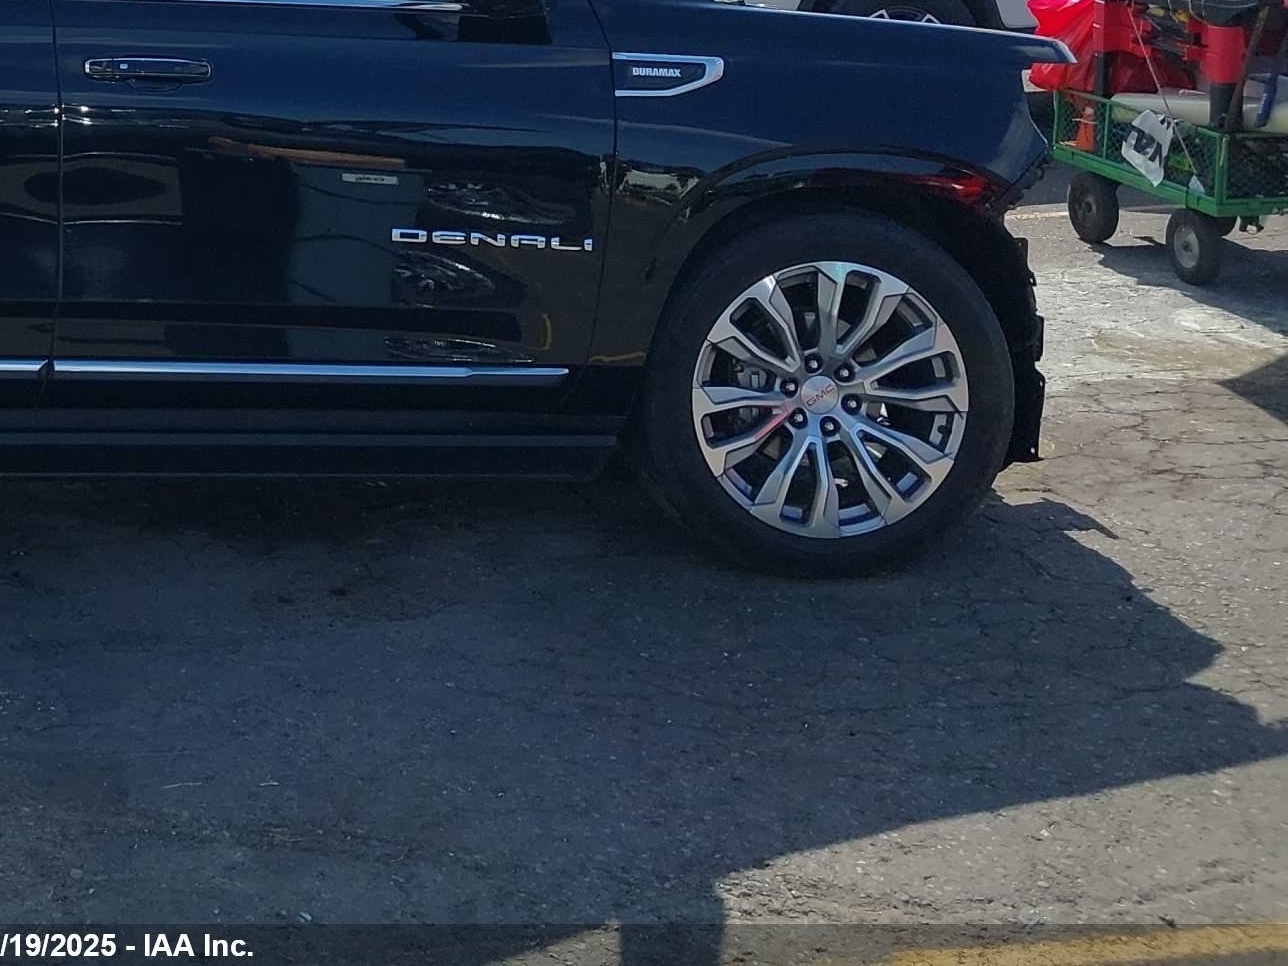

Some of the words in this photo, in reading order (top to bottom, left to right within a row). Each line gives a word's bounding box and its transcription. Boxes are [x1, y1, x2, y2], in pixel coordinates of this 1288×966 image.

[632, 67, 682, 78] DURAMAX
[391, 228, 594, 252] DENALI
[806, 383, 836, 407] GMC
